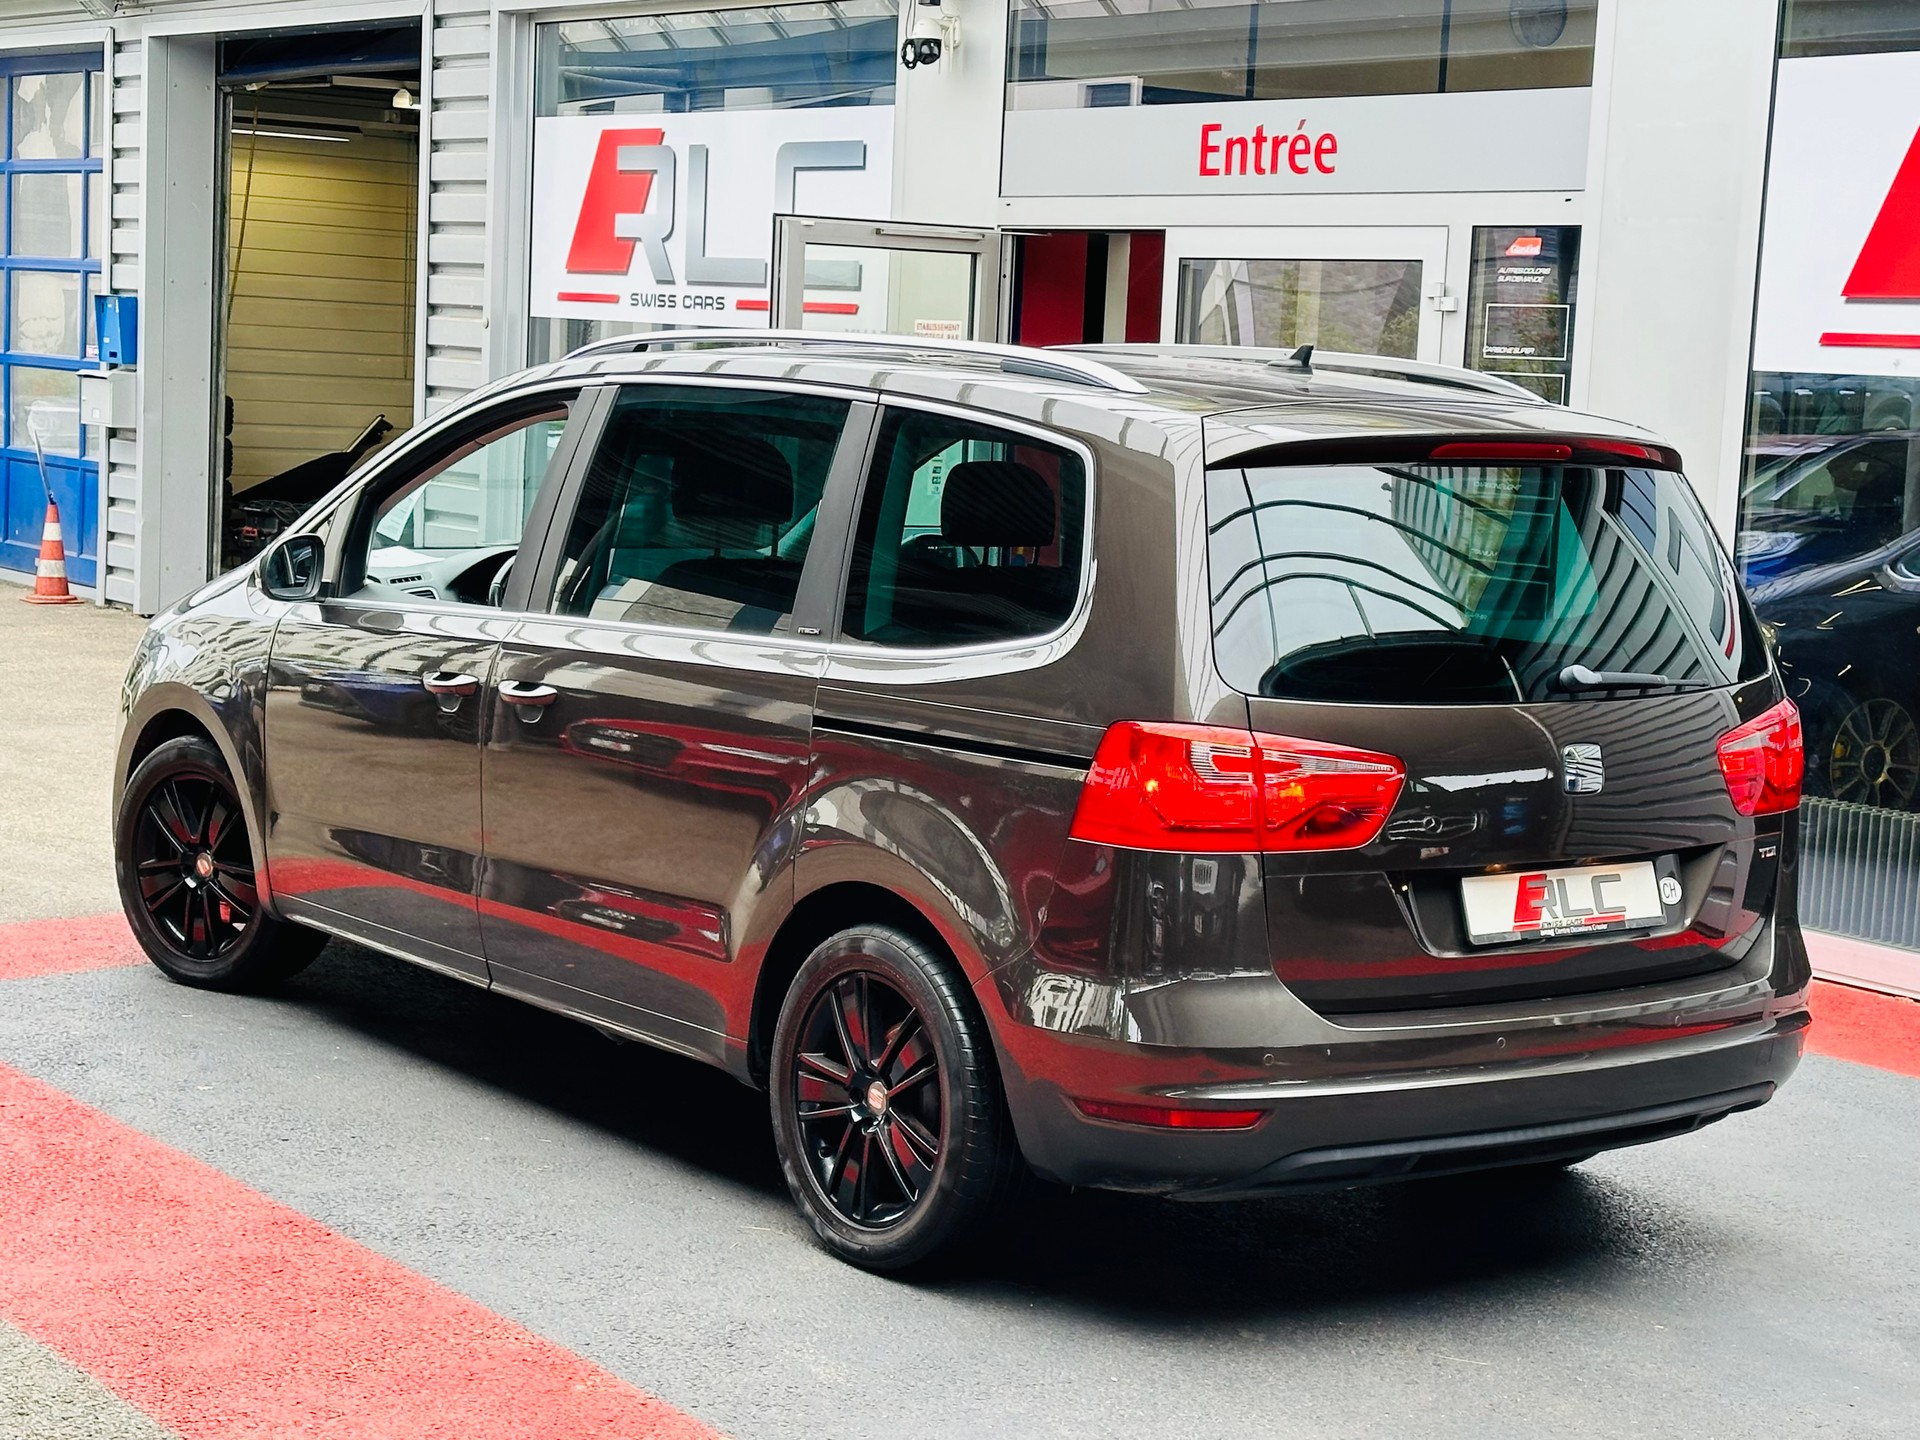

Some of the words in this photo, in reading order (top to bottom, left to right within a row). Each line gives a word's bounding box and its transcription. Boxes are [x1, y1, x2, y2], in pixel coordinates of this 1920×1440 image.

[1199, 119, 1338, 177] Entrée
[630, 292, 677, 309] SWISS
[682, 294, 726, 311] CARS
[1759, 845, 1776, 858] TDI
[1514, 873, 1626, 923] ERLC
[1662, 881, 1678, 899] CH
